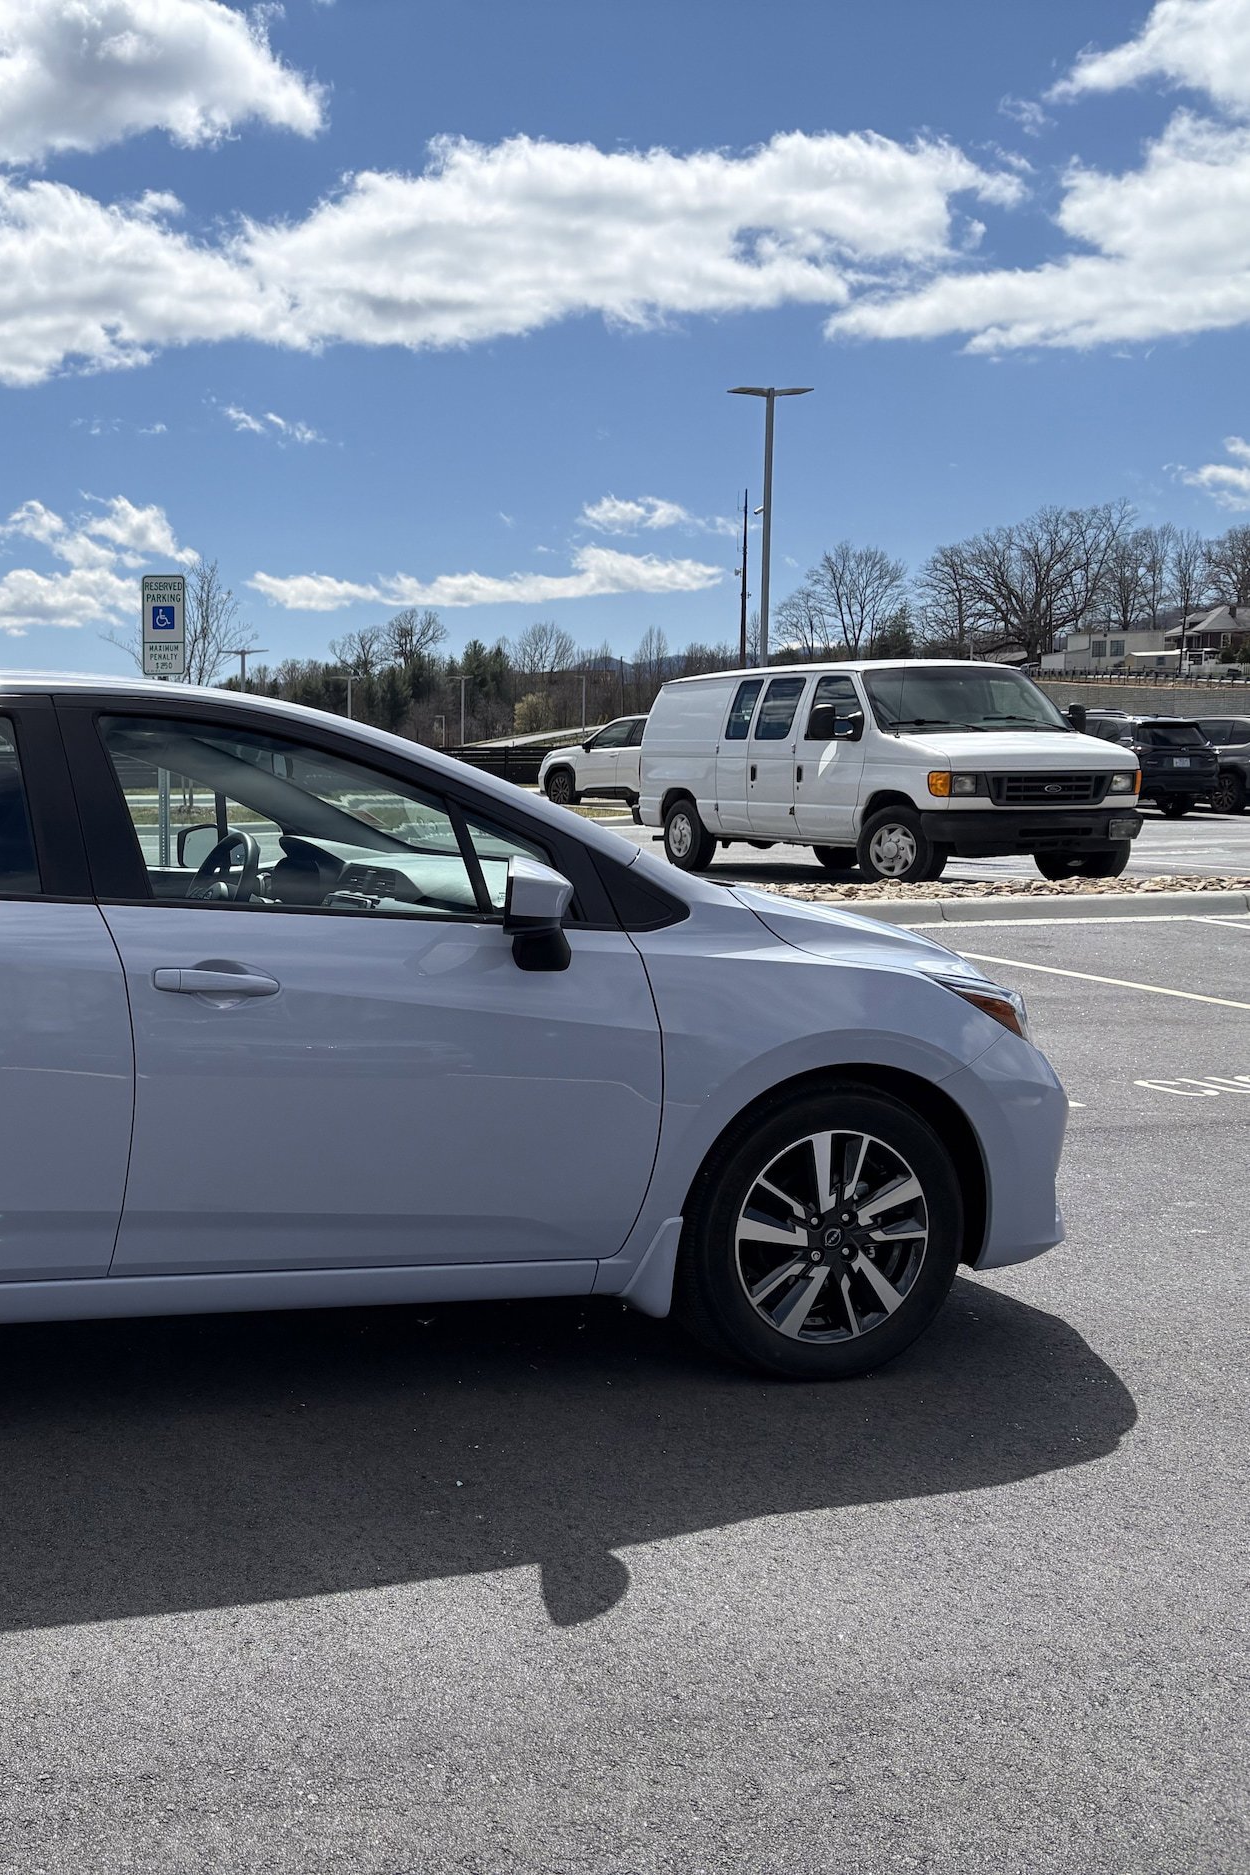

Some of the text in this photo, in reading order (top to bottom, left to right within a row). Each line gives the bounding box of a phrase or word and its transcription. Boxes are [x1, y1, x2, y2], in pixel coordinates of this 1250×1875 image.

[144, 581, 183, 591] RESERVED
[146, 593, 181, 603] PARKING
[149, 644, 179, 652] MAXIMUM
[149, 653, 178, 661] PENALTY
